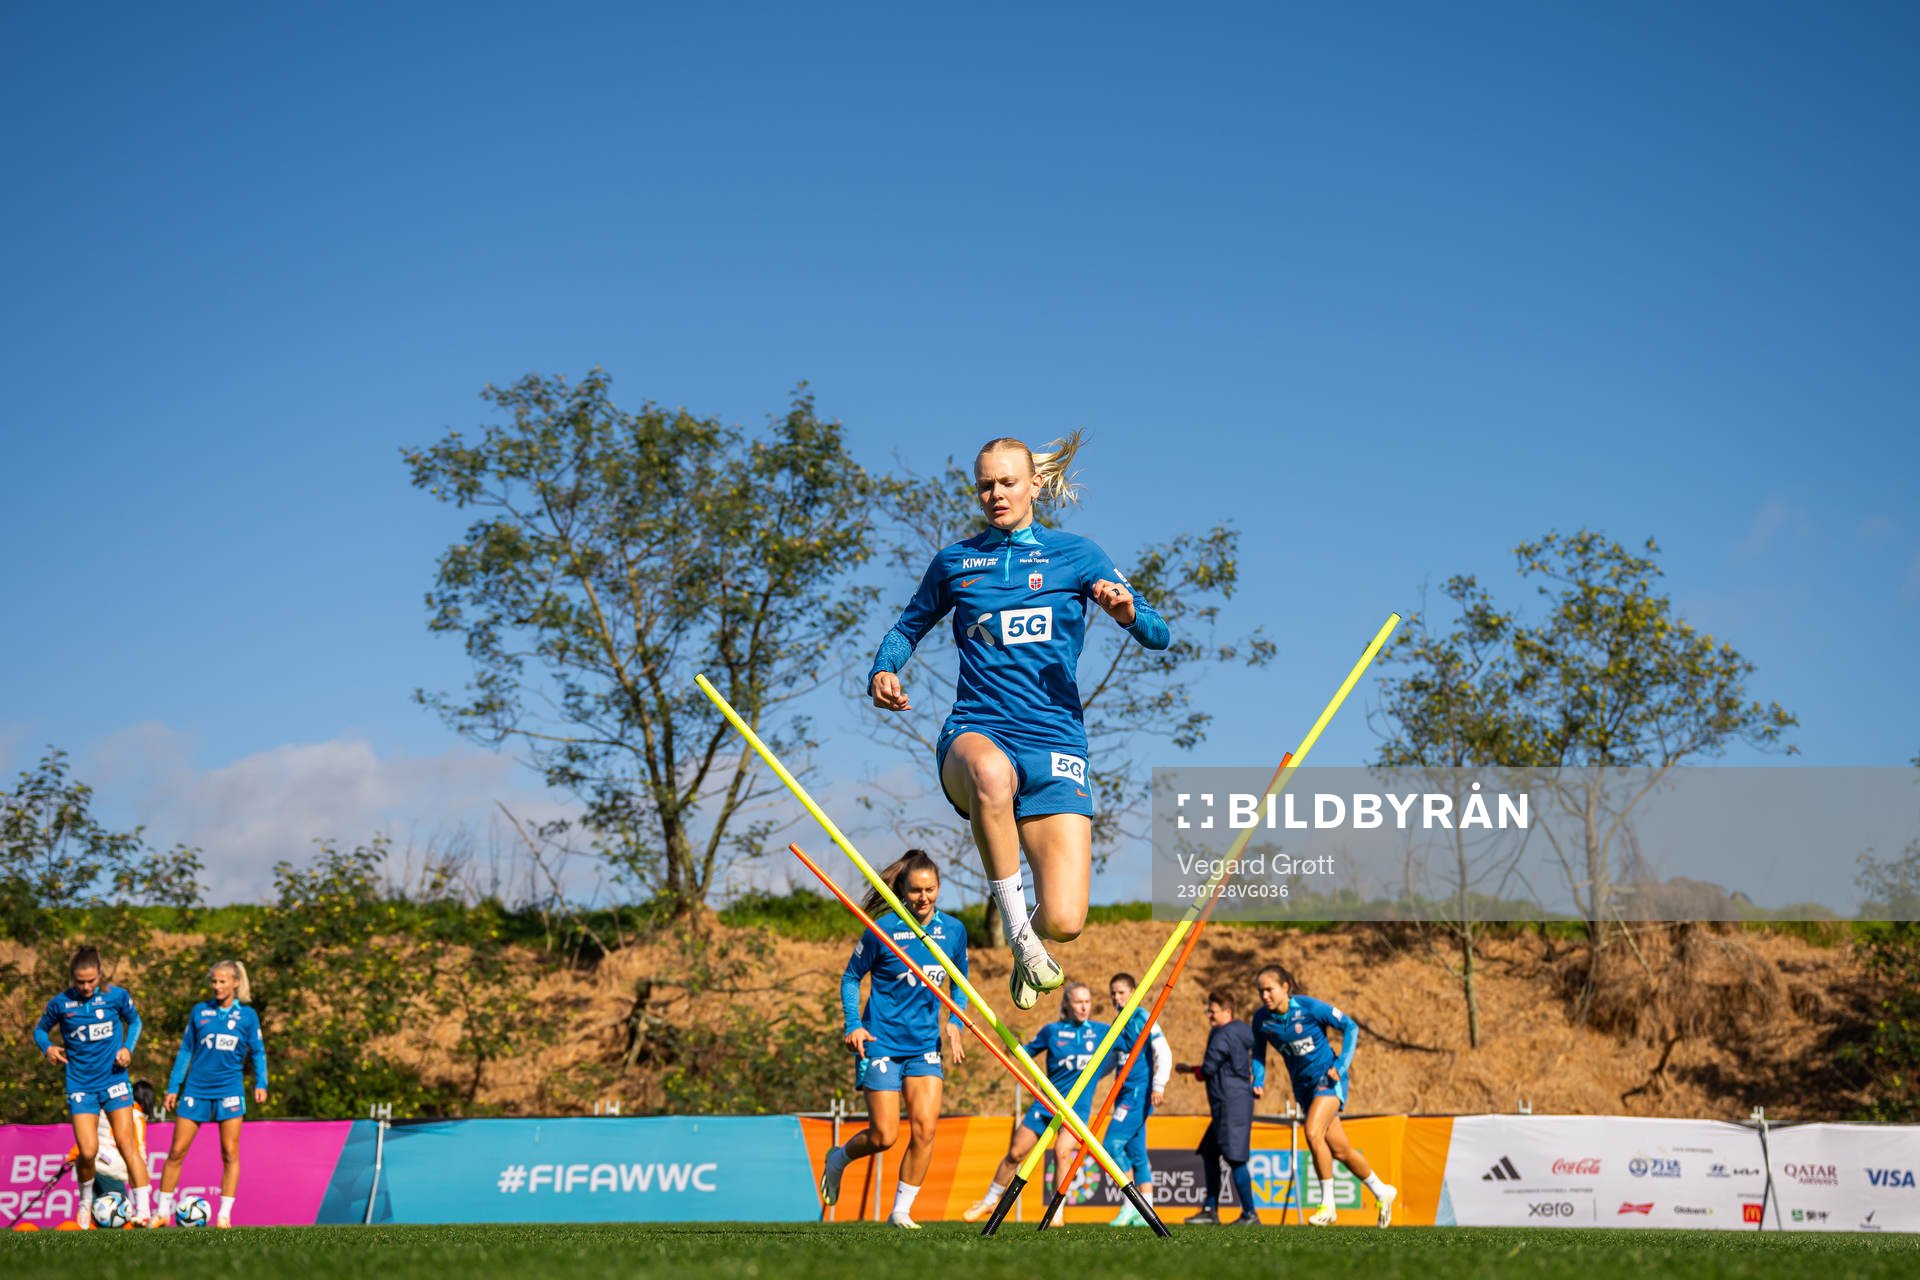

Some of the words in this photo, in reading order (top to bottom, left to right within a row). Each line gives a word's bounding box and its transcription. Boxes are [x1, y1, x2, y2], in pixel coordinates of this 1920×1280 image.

[963, 557, 987, 569] KIWI
[1008, 614, 1047, 638] 5G
[1055, 757, 1085, 779] 5G
[1248, 1154, 1294, 1179] AU
[1784, 1163, 1838, 1179] QATAR
[497, 1163, 718, 1193] #FIFAWWC
[1865, 1168, 1916, 1188] VISA
[1250, 1179, 1296, 1204] NZ
[1528, 1201, 1574, 1218] xero
